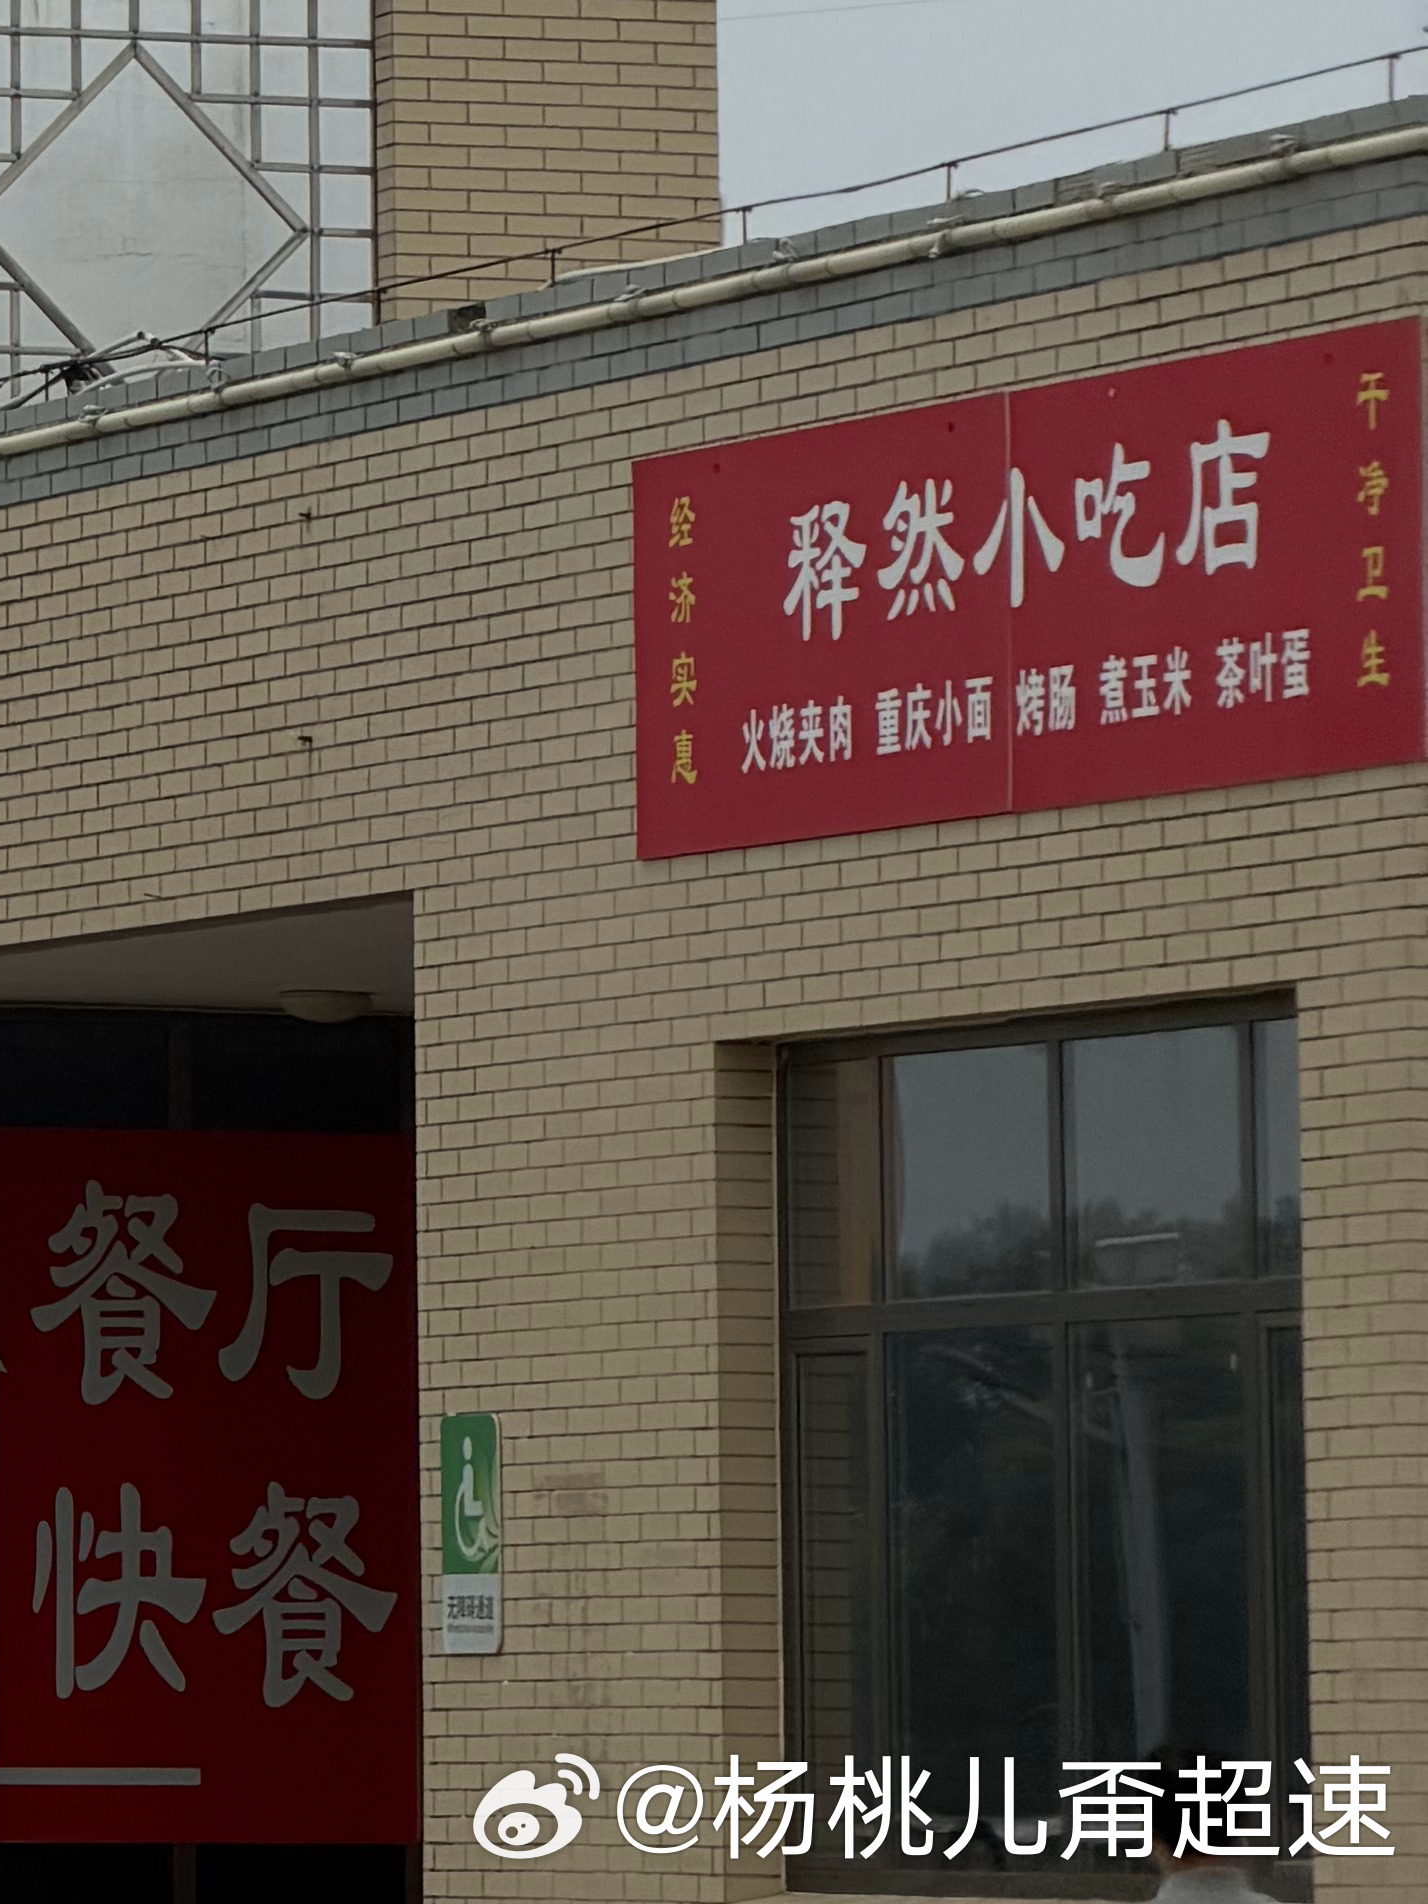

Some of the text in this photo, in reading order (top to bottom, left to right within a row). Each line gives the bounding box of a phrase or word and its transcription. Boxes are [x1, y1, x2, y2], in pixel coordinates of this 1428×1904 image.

[667, 495, 699, 786] 经济实惠
[783, 419, 1271, 643] 释然小吃店
[1354, 372, 1391, 690] 干净卫生
[741, 628, 1311, 775] 火烧夹肉 重庆小面 烤肠 煮玉米 茶叶蛋
[30, 1179, 394, 1406] 餐厅
[32, 1481, 398, 1709] 快餐
